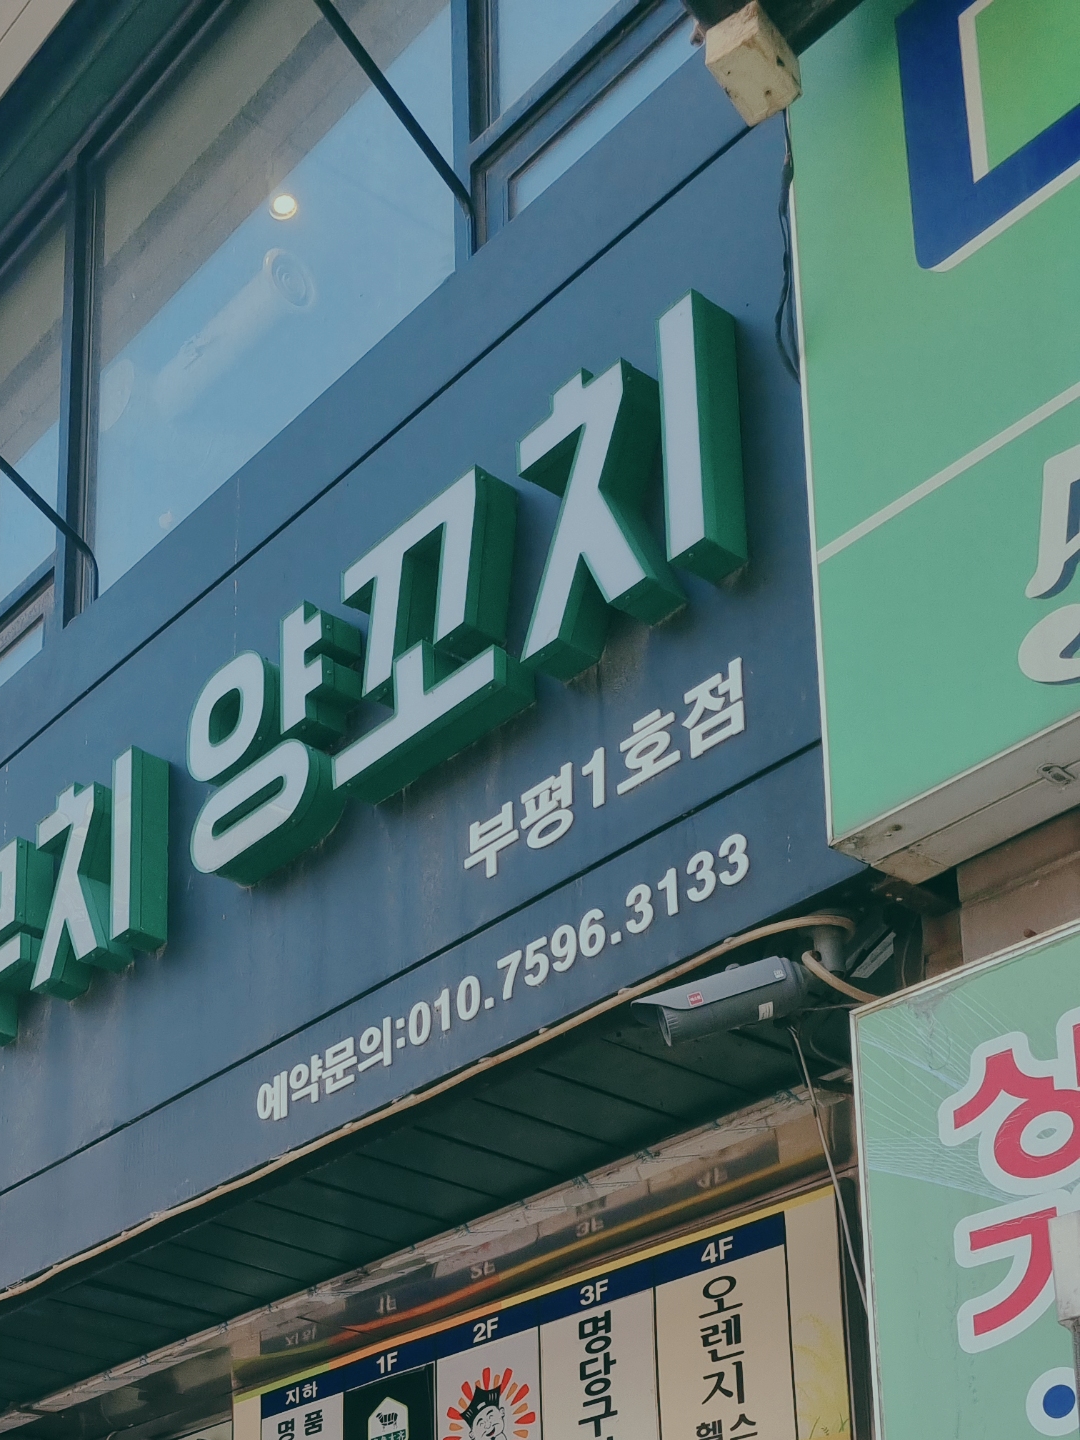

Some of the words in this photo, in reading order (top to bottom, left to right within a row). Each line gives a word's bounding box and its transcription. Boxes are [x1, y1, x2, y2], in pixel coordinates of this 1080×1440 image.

[187, 288, 710, 874] 양꼬치
[463, 656, 745, 879] 부평1호점
[700, 1235, 735, 1265] 4F
[579, 1280, 609, 1306] 3F
[472, 1317, 499, 1344] 2F
[697, 1274, 746, 1406] 오렌지
[376, 1352, 398, 1374] 1F
[285, 1382, 319, 1406] 지하
